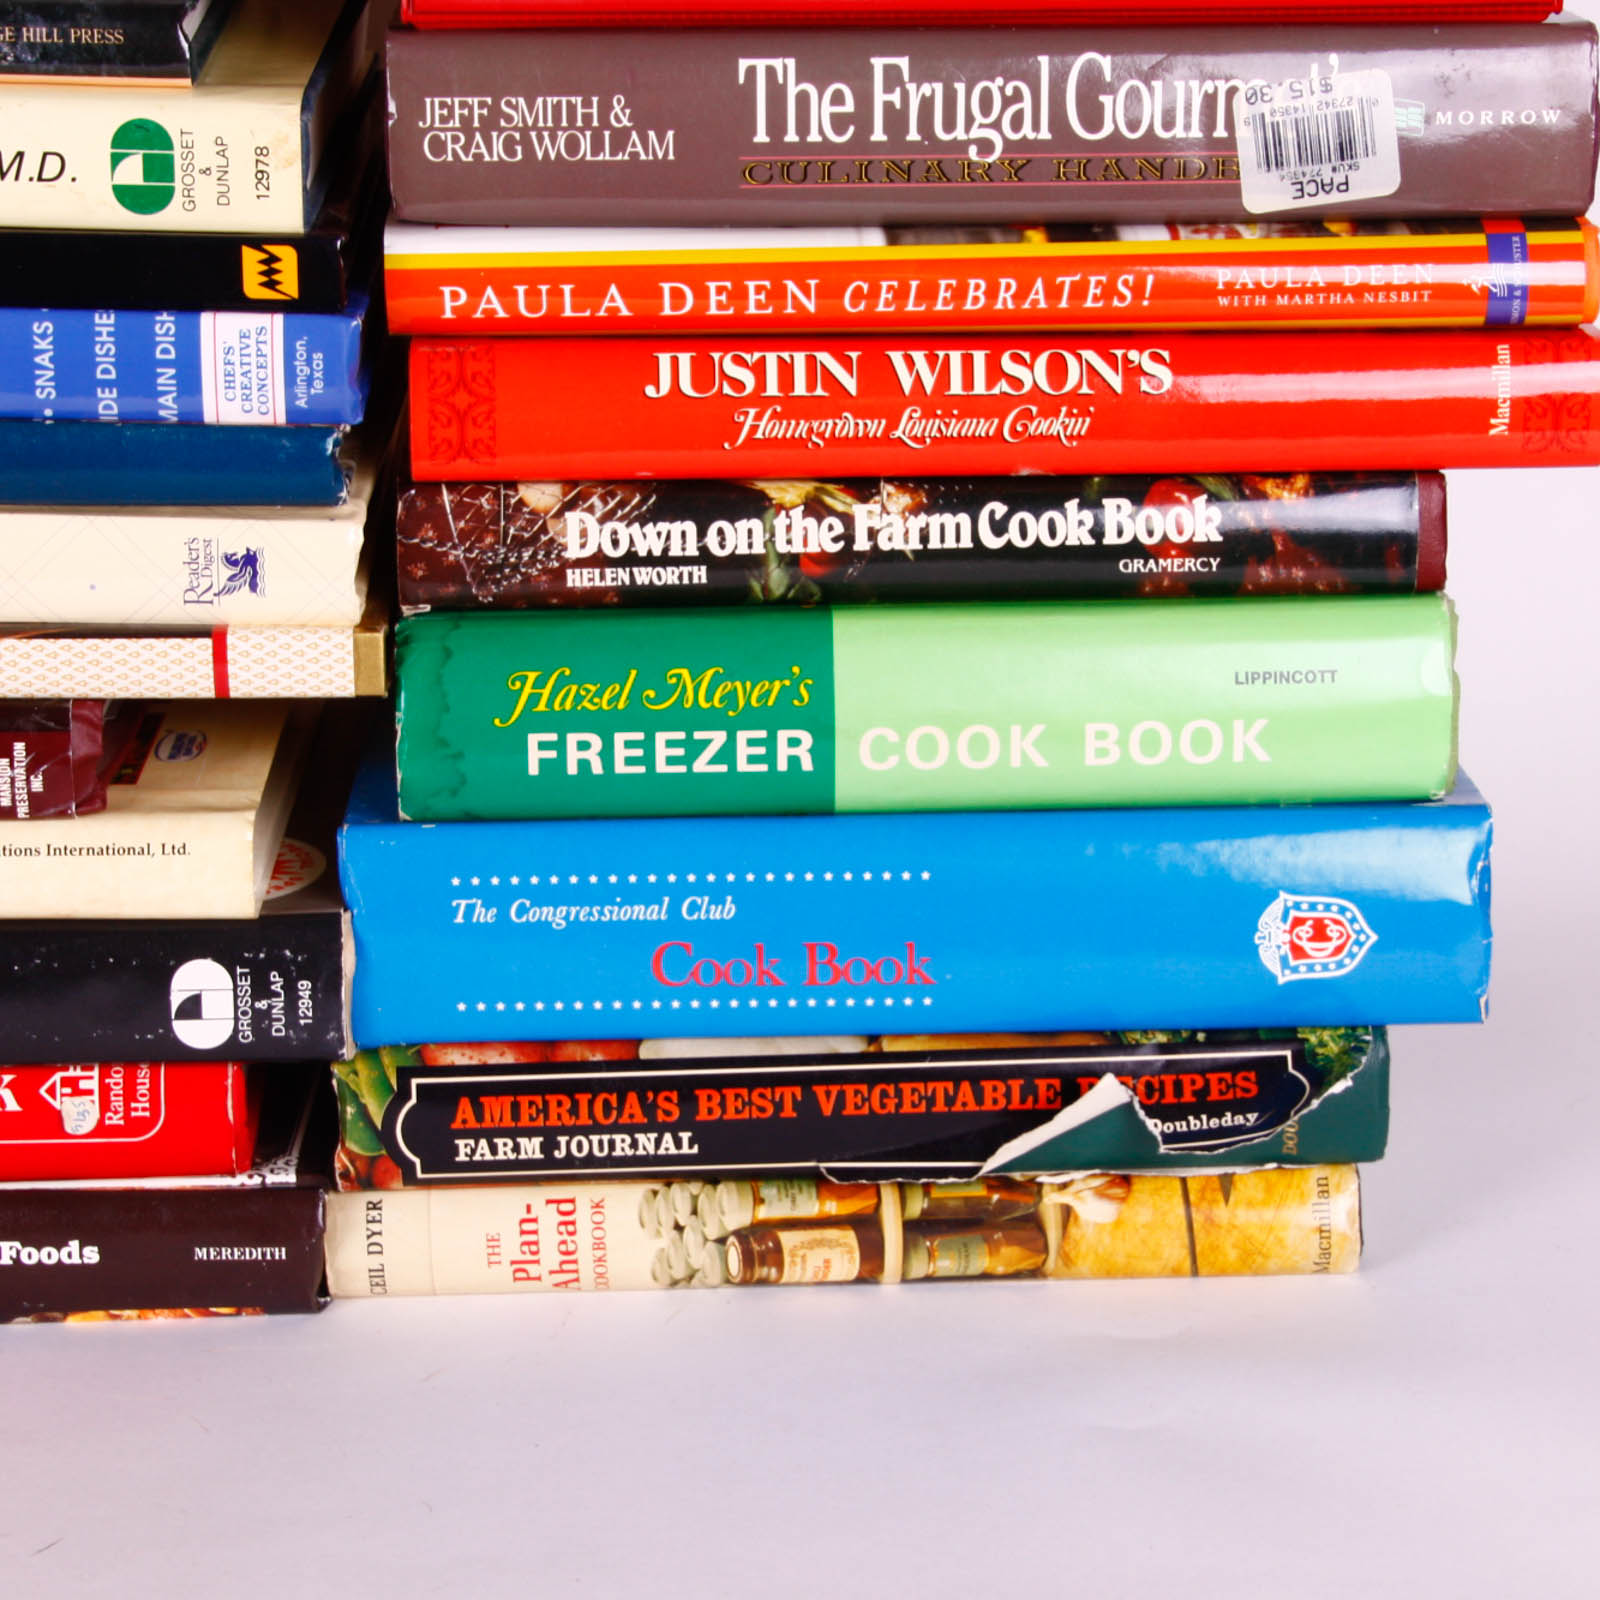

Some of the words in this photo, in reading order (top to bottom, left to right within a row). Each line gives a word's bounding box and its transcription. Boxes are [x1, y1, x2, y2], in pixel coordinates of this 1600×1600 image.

[22, 27, 64, 44] HILL
[70, 28, 125, 44] PRESS
[418, 97, 492, 129] JEFF
[499, 95, 600, 128] SMITH
[609, 94, 634, 128] &
[738, 56, 855, 144] The
[870, 54, 1052, 163] Frugal
[1244, 76, 1334, 106] $15.30
[1435, 109, 1562, 126] MORROW
[423, 130, 523, 163] CRAIG
[530, 129, 676, 162] WOLLAM
[181, 128, 197, 212] GROSSET
[200, 166, 213, 177] &
[215, 136, 231, 207] DUNLAP
[255, 145, 271, 200] 12978
[742, 158, 1033, 186] CULINARY
[1291, 174, 1350, 200] PACE
[440, 282, 634, 319] PAULA
[659, 279, 819, 316] DEEN
[843, 274, 1155, 312] CELEBRATES!
[1215, 267, 1327, 290] PAULA
[1342, 263, 1434, 286] DEEN
[1217, 294, 1267, 308] WITH
[1276, 292, 1355, 306] MARTHA
[1363, 290, 1433, 304] NESBIT
[33, 320, 57, 401] SNAKS
[94, 309, 118, 379] DISHE
[223, 340, 237, 402] CHEFS'
[238, 328, 253, 414] CREATIVE
[255, 325, 270, 416] CONCEPTS
[294, 336, 310, 408] Arlington,
[311, 352, 324, 395] Texas
[644, 351, 862, 399] JUSTIN
[885, 348, 1173, 397] WILSON'S
[1489, 343, 1511, 436] Macmillan
[94, 387, 119, 421] IDE
[723, 404, 886, 450] Homegrown
[889, 405, 1000, 449] Louisiana
[563, 510, 699, 560] Down
[706, 519, 767, 555] on
[773, 504, 845, 554] the
[852, 502, 974, 552] Farm
[977, 497, 1096, 550] Cook
[1101, 494, 1223, 545] Book
[183, 537, 214, 605] Reader's
[201, 539, 217, 577] Digest
[565, 566, 632, 588] HELEN
[634, 565, 708, 586] WORTH
[1118, 557, 1221, 574] GRAMERCY
[493, 667, 638, 728] Hazel
[642, 664, 814, 717] Meyer's
[1234, 669, 1339, 685] LIPPINCOTT
[526, 729, 814, 776] FREEZER
[859, 723, 1049, 771] COOK
[1083, 719, 1270, 768] BOOK
[0, 757, 13, 807] MANSION
[13, 741, 30, 819] PRESERVATION
[30, 770, 44, 793] INC.
[0, 842, 41, 857] tions
[46, 843, 156, 859] International,
[161, 842, 191, 857] Ltd.
[451, 898, 498, 925] The
[509, 896, 670, 930] Congressional
[681, 894, 736, 921] Club
[651, 940, 787, 987] Cook
[802, 940, 938, 987] Book
[236, 965, 252, 1044] GROSSET
[255, 998, 269, 1011] &
[270, 971, 285, 1037] DUNLAP
[298, 980, 313, 1026] 12949
[105, 1063, 125, 1126] Rando
[450, 1090, 681, 1130] AMERICA'S
[695, 1085, 802, 1122] BEST
[812, 1077, 1063, 1117] VEGETABLE
[454, 1136, 544, 1162] FARM
[553, 1131, 700, 1159] JOURNAL
[366, 1198, 384, 1257] DYER
[510, 1203, 543, 1285] Plan-
[545, 1196, 581, 1291] Ahead
[590, 1197, 609, 1289] OOKBOOK
[1311, 1175, 1331, 1275] Macmillan
[0, 1240, 100, 1264] Foods
[193, 1246, 287, 1261] MEREDITH
[486, 1232, 502, 1269] THE
